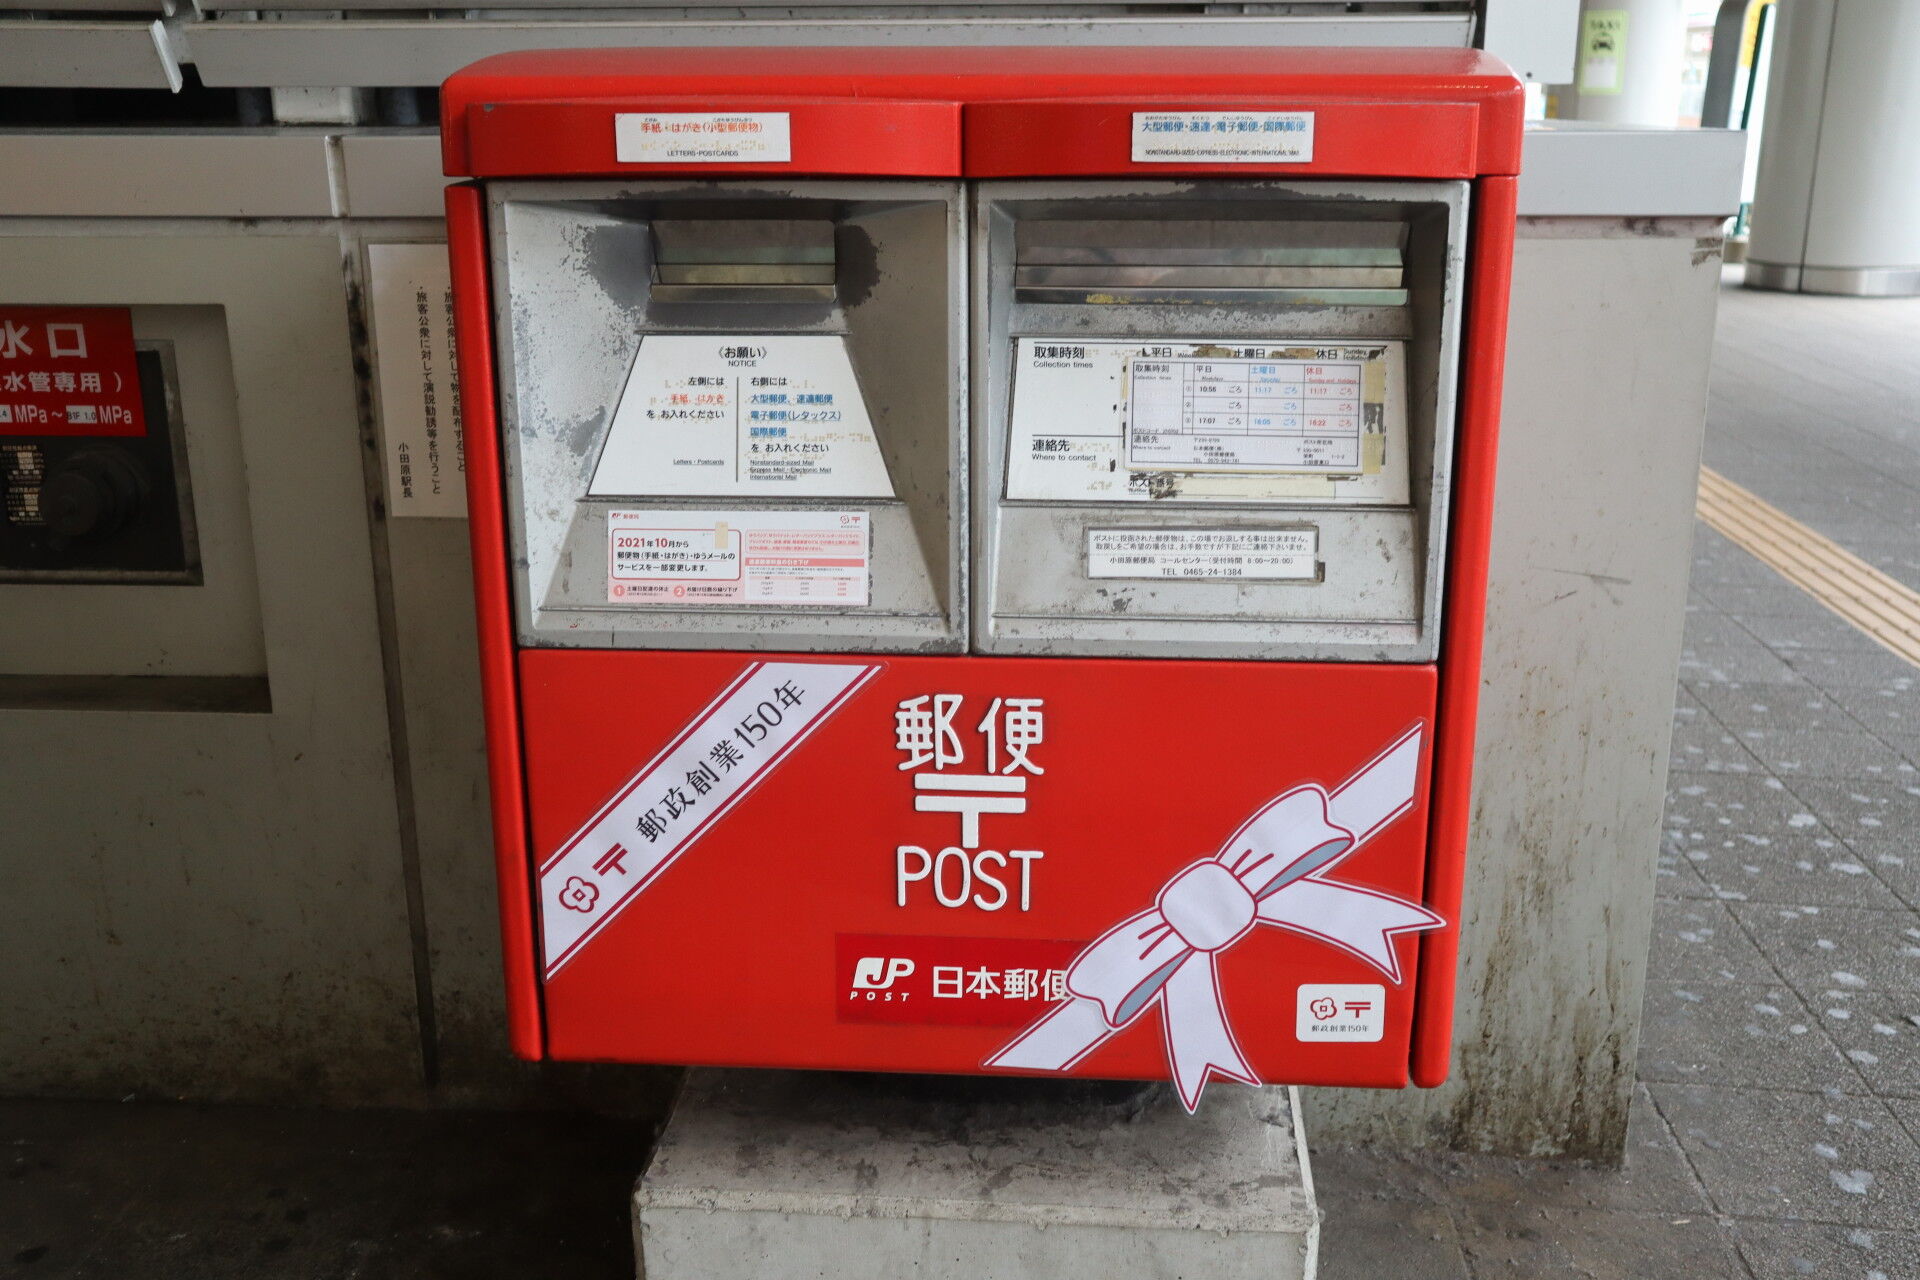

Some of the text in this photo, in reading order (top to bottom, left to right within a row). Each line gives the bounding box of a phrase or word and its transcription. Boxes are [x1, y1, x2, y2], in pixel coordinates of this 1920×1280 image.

[1034, 347, 1084, 359] 取集時刻
[1152, 348, 1172, 358] 平日
[1234, 348, 1265, 358] 土曜日
[1317, 350, 1338, 360] 休日
[1135, 364, 1170, 373] 取集時刻
[1251, 366, 1276, 374] 土曜日
[1306, 367, 1322, 375] 休日
[688, 376, 724, 387] 左側には
[750, 376, 787, 387] 右側には
[15, 405, 48, 424] MPa
[100, 406, 132, 424] MPa
[750, 426, 788, 438] 国際郵便
[1134, 436, 1158, 444] 連絡先
[1032, 440, 1070, 452] 連絡先
[398, 442, 412, 498] 小田原駅長
[618, 538, 689, 548] 2021年10月から
[617, 552, 736, 560] 郵便物(手紙・はがき)・ゆうメールの
[618, 564, 708, 572] サービスを一部変更します。
[1183, 568, 1242, 576] 0465-24-1384
[895, 694, 1044, 775] 郵便
[635, 680, 805, 842] 郵政創業150年
[896, 846, 1044, 911] POST
[933, 966, 1068, 1002] 日本郵便
[850, 991, 910, 1002] POST
